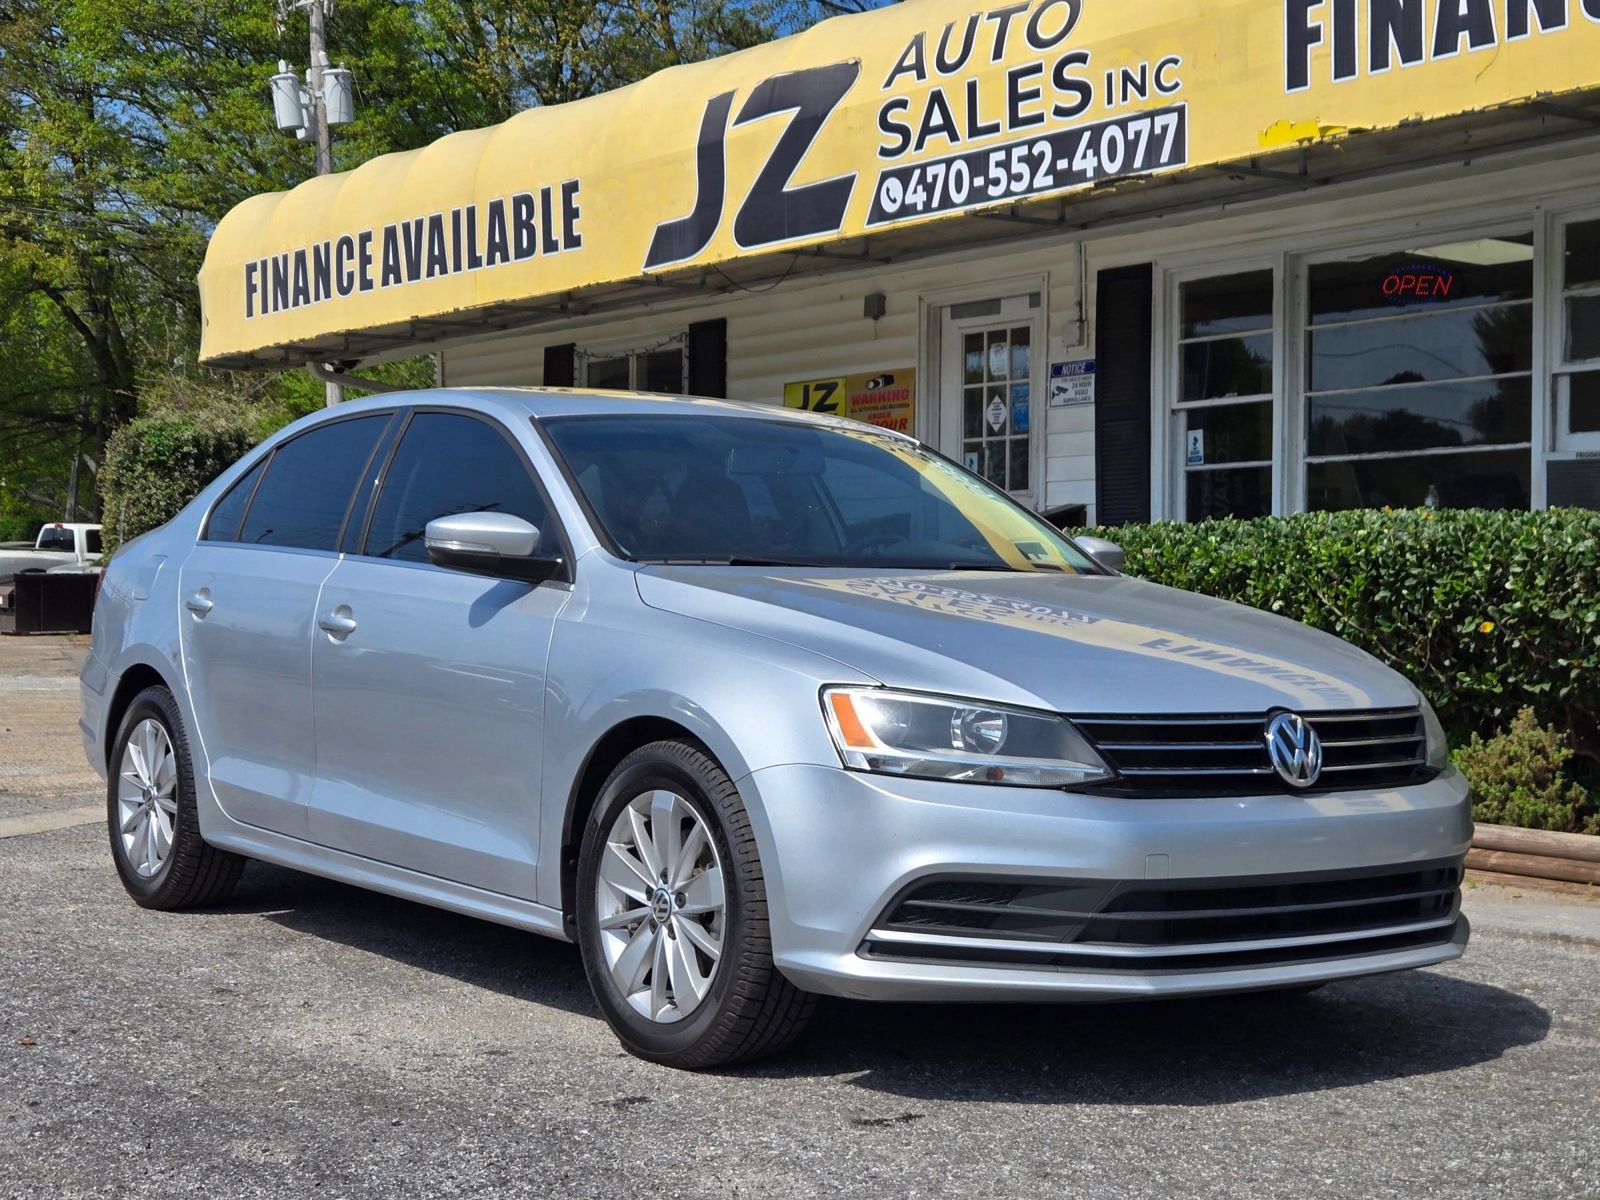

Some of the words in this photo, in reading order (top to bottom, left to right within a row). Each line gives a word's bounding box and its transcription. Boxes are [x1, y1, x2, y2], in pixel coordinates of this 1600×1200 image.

[881, 0, 1082, 91] AUTO
[1285, 0, 1600, 94] FINA
[877, 51, 1094, 159] SALES
[1104, 55, 1183, 108] INC
[643, 58, 862, 272] JZ
[904, 111, 1180, 212] 470-552-4077
[244, 229, 375, 319] FINANCE
[380, 178, 583, 288] AVAILABLE
[1382, 274, 1453, 296] OPEN
[797, 381, 839, 413] JZ
[852, 389, 910, 406] WARNING
[1061, 362, 1086, 376] NOTICE
